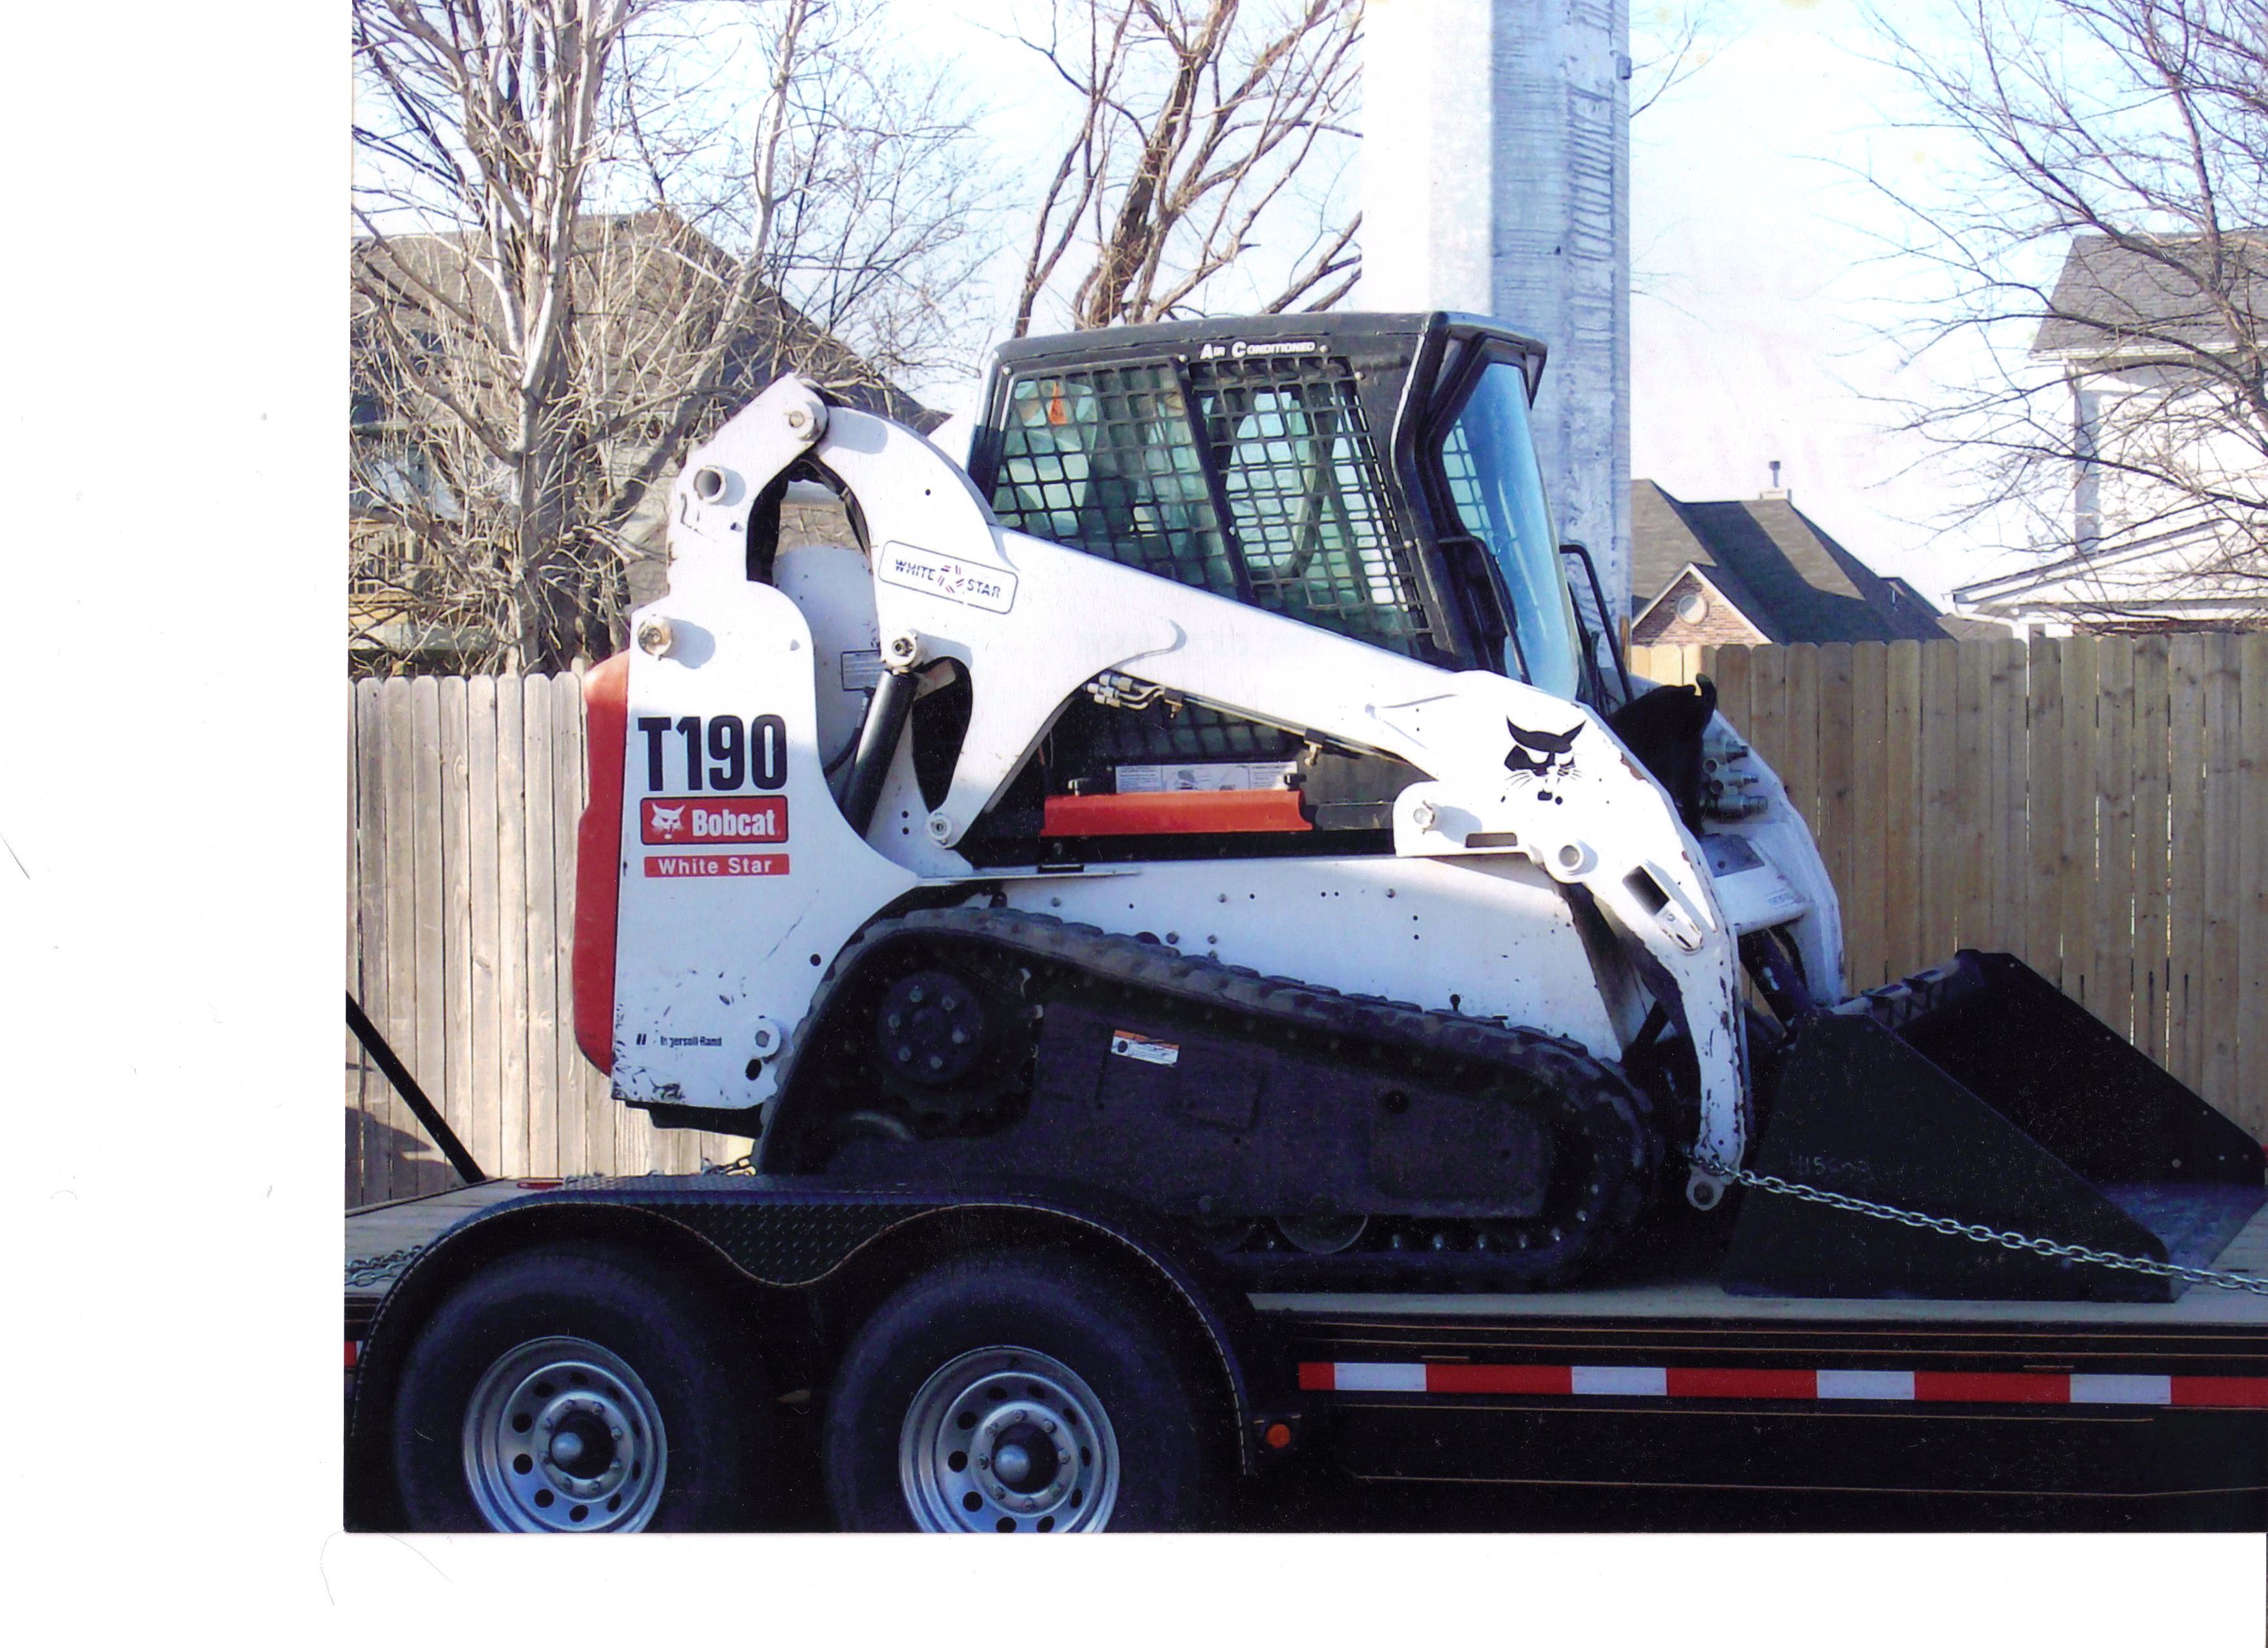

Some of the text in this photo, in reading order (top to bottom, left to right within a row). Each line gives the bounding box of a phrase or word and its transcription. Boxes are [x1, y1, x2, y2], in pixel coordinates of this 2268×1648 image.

[895, 558, 1001, 599] WHITE STAR
[638, 714, 788, 792] T190
[692, 808, 775, 837] Bobcat
[658, 857, 773, 875] White Star
